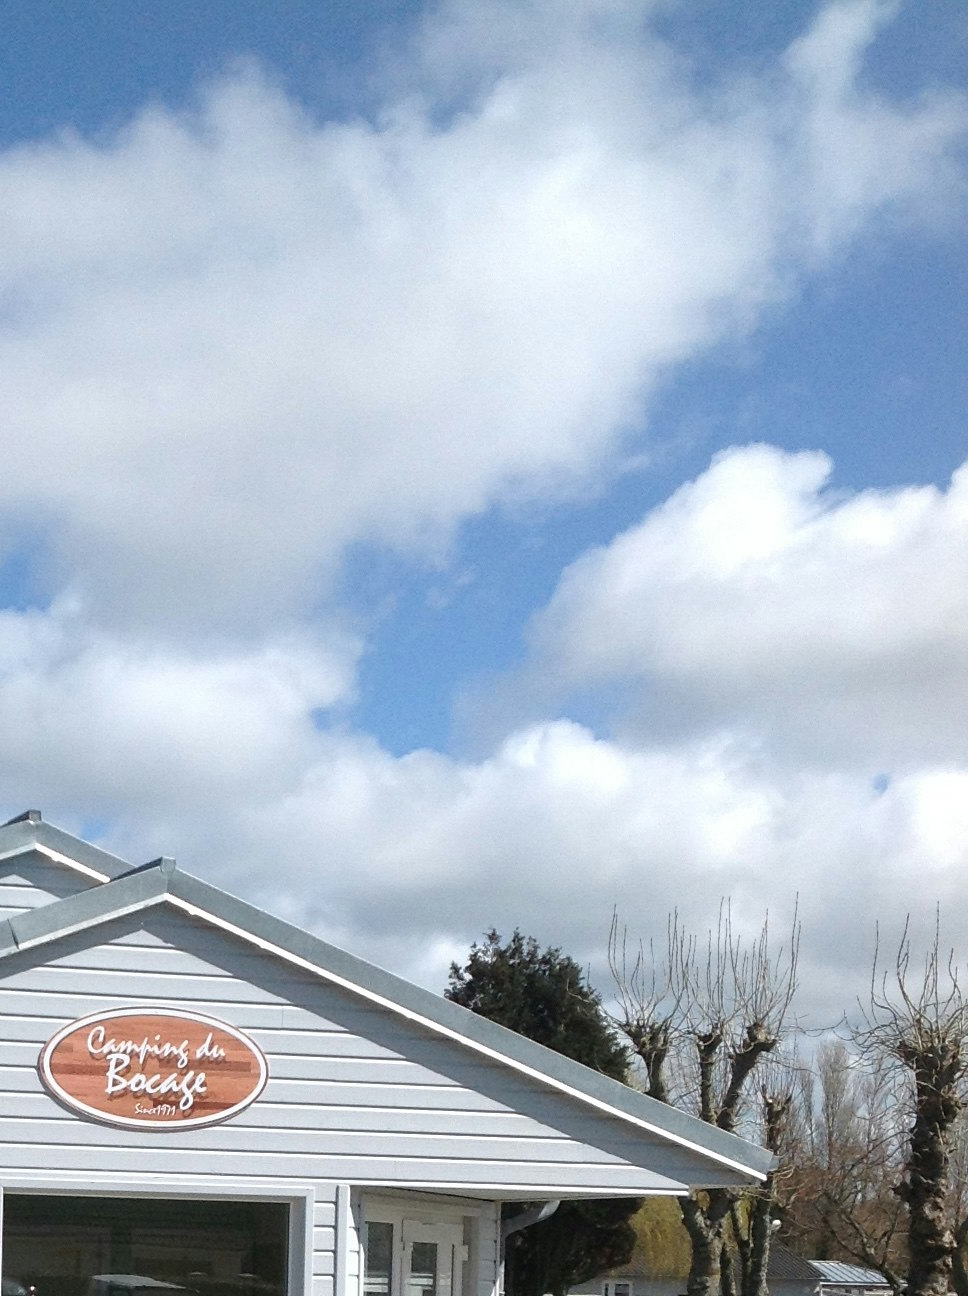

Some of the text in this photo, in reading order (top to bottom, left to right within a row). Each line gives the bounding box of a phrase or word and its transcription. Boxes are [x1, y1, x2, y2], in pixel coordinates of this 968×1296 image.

[87, 1025, 226, 1069] Camping du
[105, 1053, 207, 1110] Bocage
